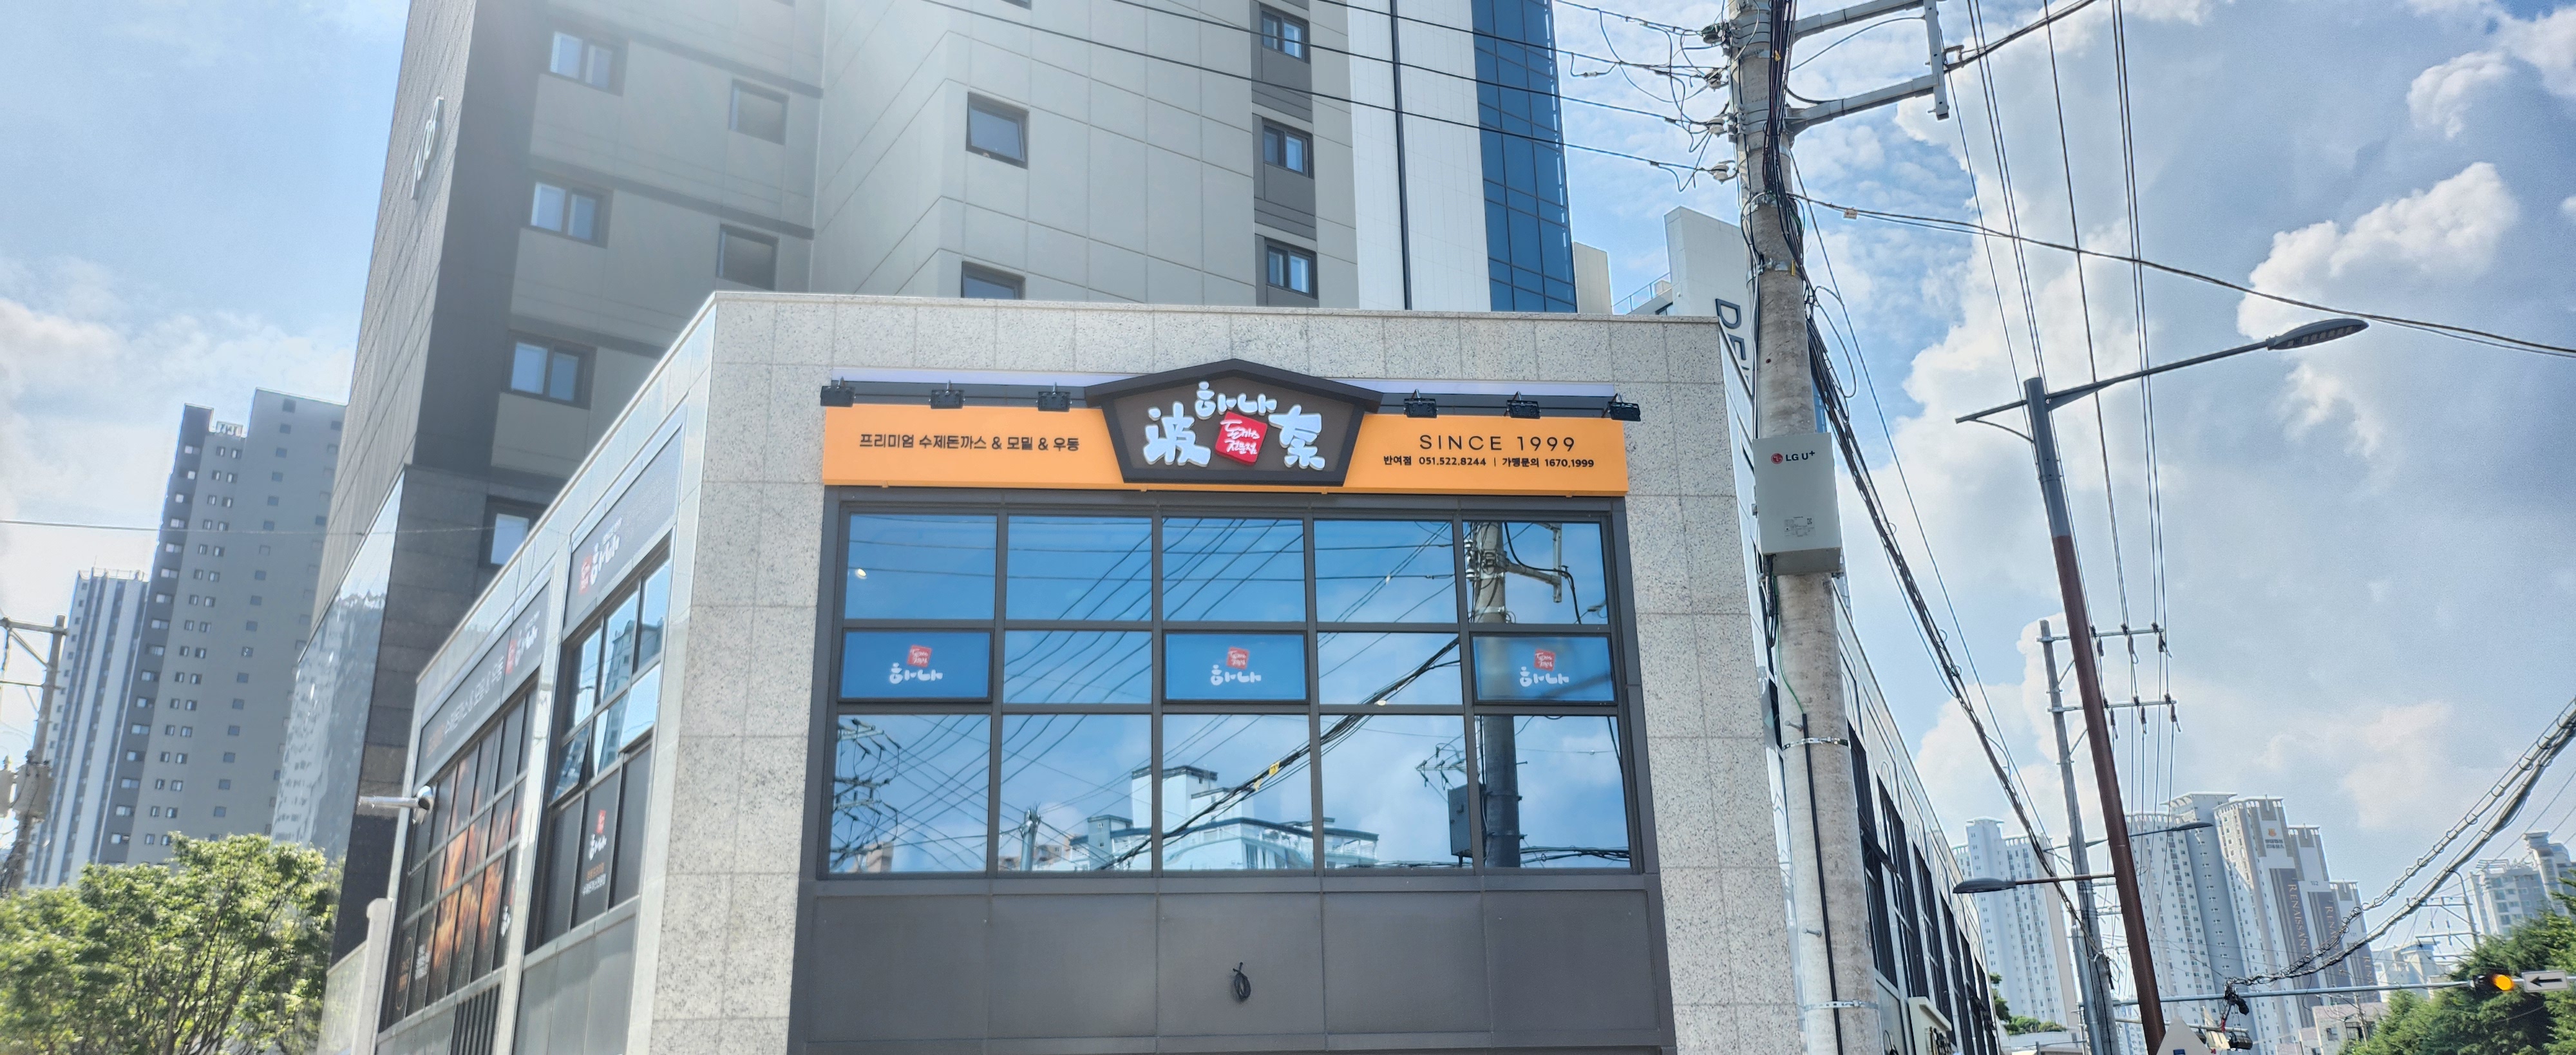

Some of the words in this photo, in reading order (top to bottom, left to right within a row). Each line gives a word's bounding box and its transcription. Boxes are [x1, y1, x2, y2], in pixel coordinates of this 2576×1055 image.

[1195, 381, 1278, 420] 하나
[859, 433, 914, 448] 프리미엄
[919, 435, 987, 450] 수제돈까스
[992, 436, 1002, 450] &
[1007, 437, 1033, 451] 모밀
[1037, 437, 1048, 451] &
[1054, 437, 1079, 452] 우동
[1419, 434, 1502, 451] SINCE
[1517, 436, 1575, 452] 1999
[1383, 455, 1412, 466] 반여점
[1419, 456, 1486, 466] 051.522.8244
[1502, 457, 1540, 468] 가맹문의
[1544, 458, 1595, 468] 1670.1999
[1785, 453, 1799, 462] LG
[889, 662, 943, 684] 하나
[1211, 664, 1262, 686] 하나
[1519, 666, 1569, 687] 하나
[2287, 883, 2311, 960] RENAISSANC
